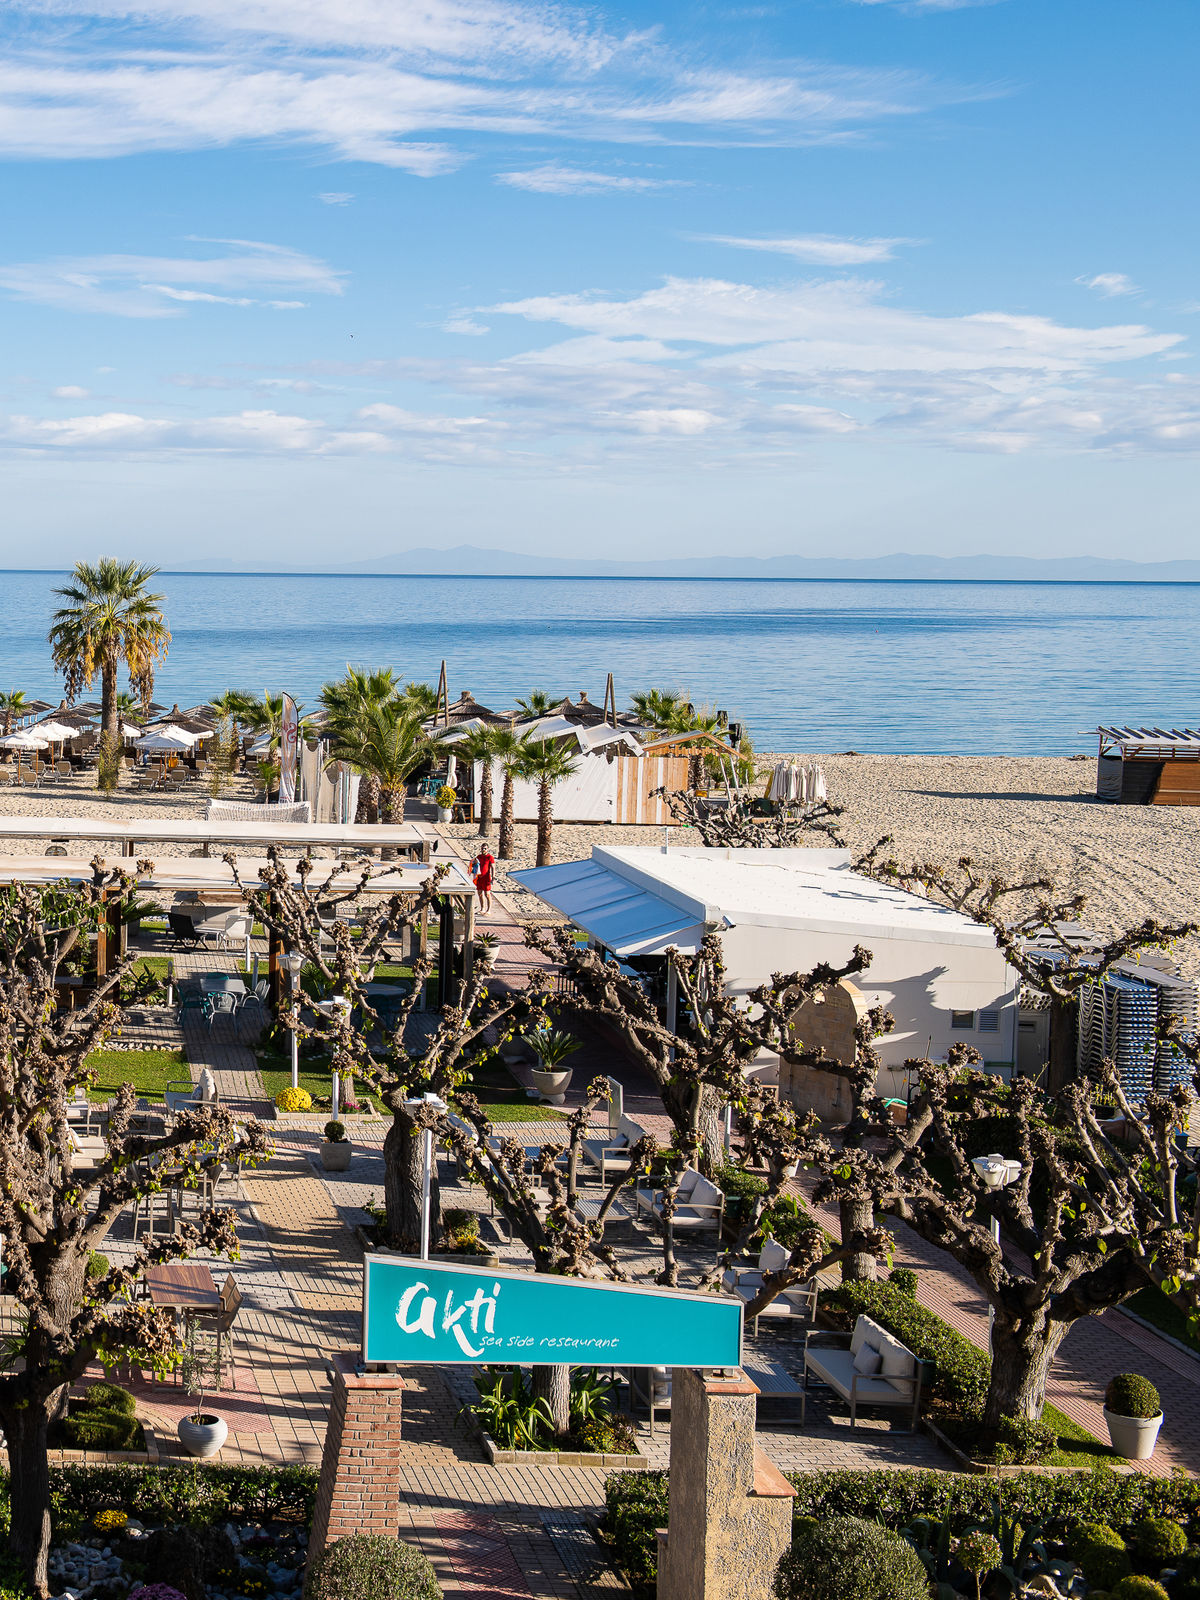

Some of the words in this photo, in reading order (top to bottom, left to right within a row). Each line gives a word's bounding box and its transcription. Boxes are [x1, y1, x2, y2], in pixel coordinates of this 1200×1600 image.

[479, 1336, 503, 1347] sea
[506, 1335, 535, 1347] side
[539, 1337, 620, 1349] restaurant
